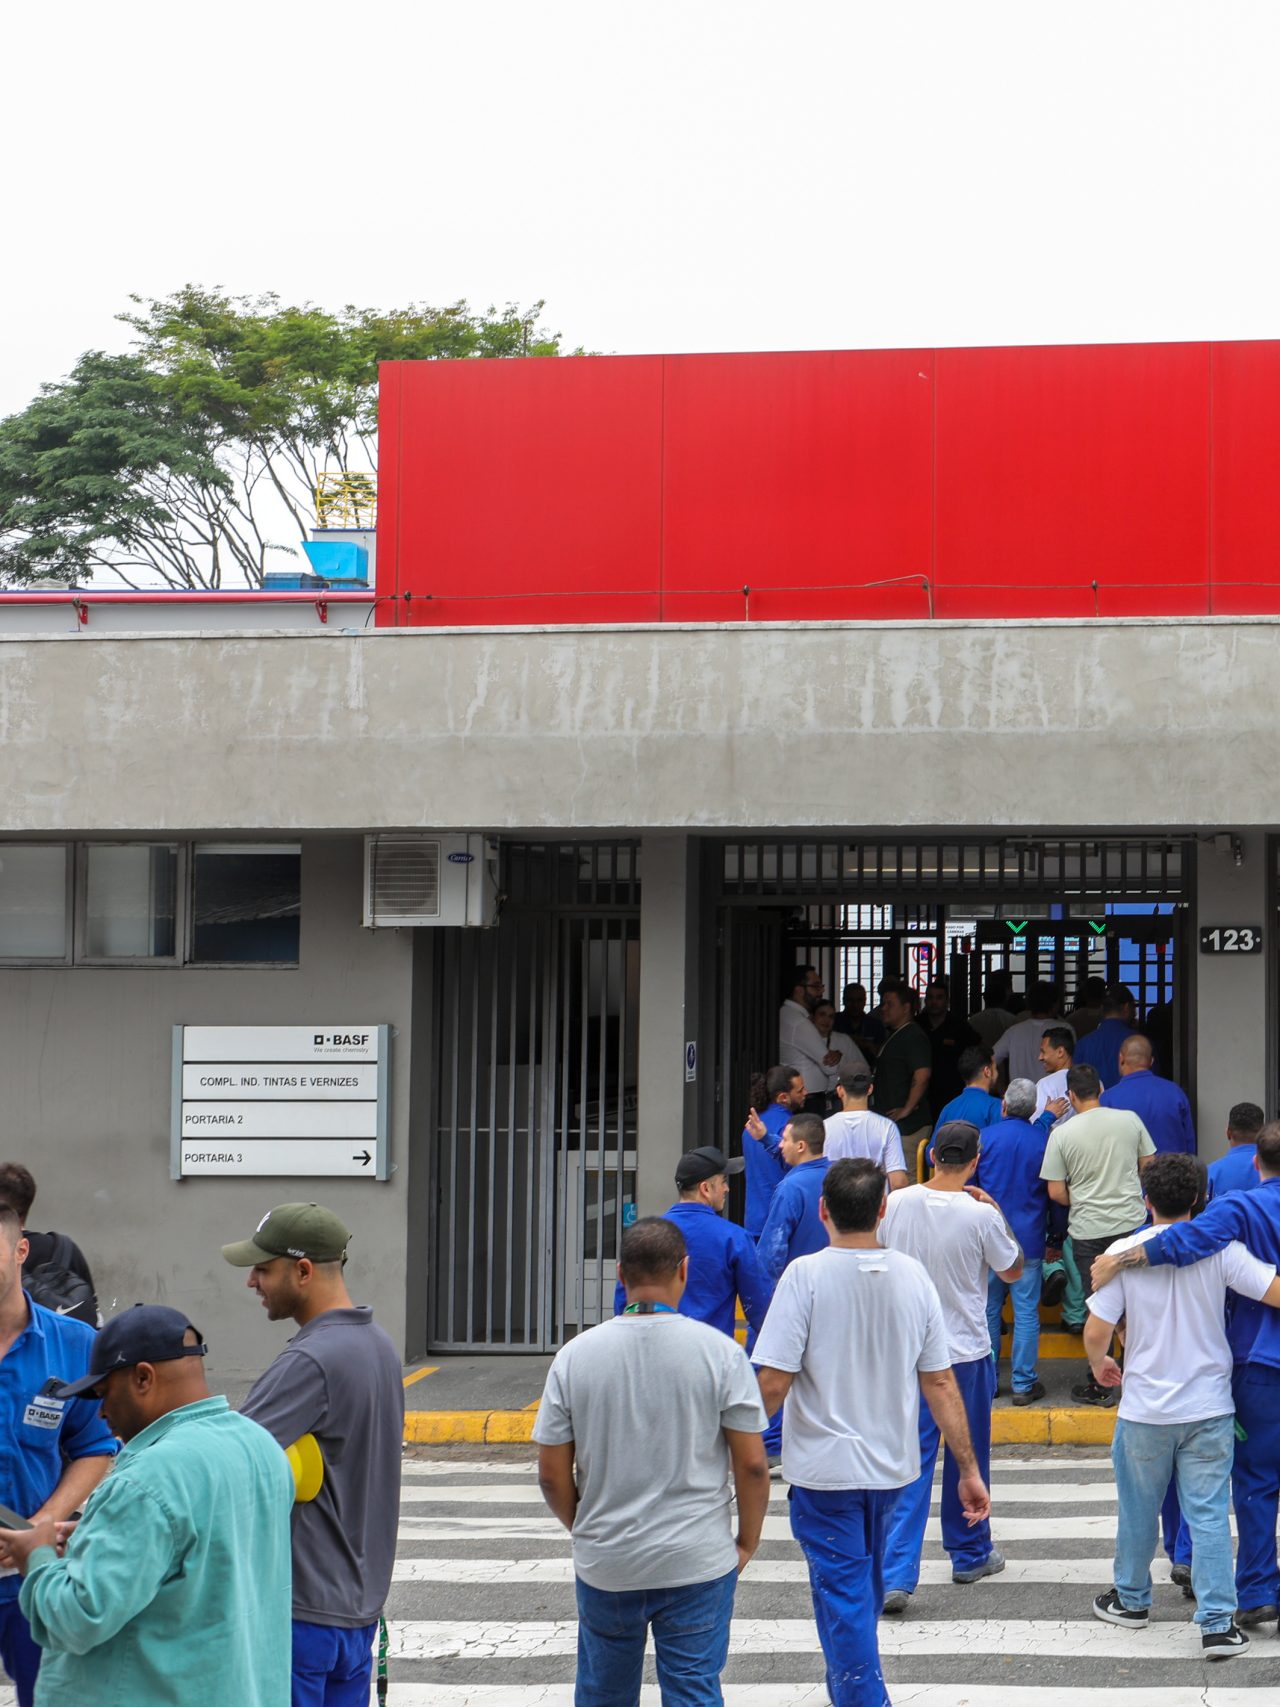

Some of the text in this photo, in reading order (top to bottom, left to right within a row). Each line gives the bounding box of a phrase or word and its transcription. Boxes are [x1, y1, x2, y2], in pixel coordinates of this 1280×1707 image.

[1208, 928, 1255, 951] 123
[333, 1034, 369, 1046] BASF
[200, 1077, 359, 1087] COMPL. IND. TINTAS E VERNIZES
[185, 1115, 243, 1125] PORTARIA 2
[184, 1153, 243, 1163] PORTARIA 3
[39, 1411, 60, 1420] BASF
